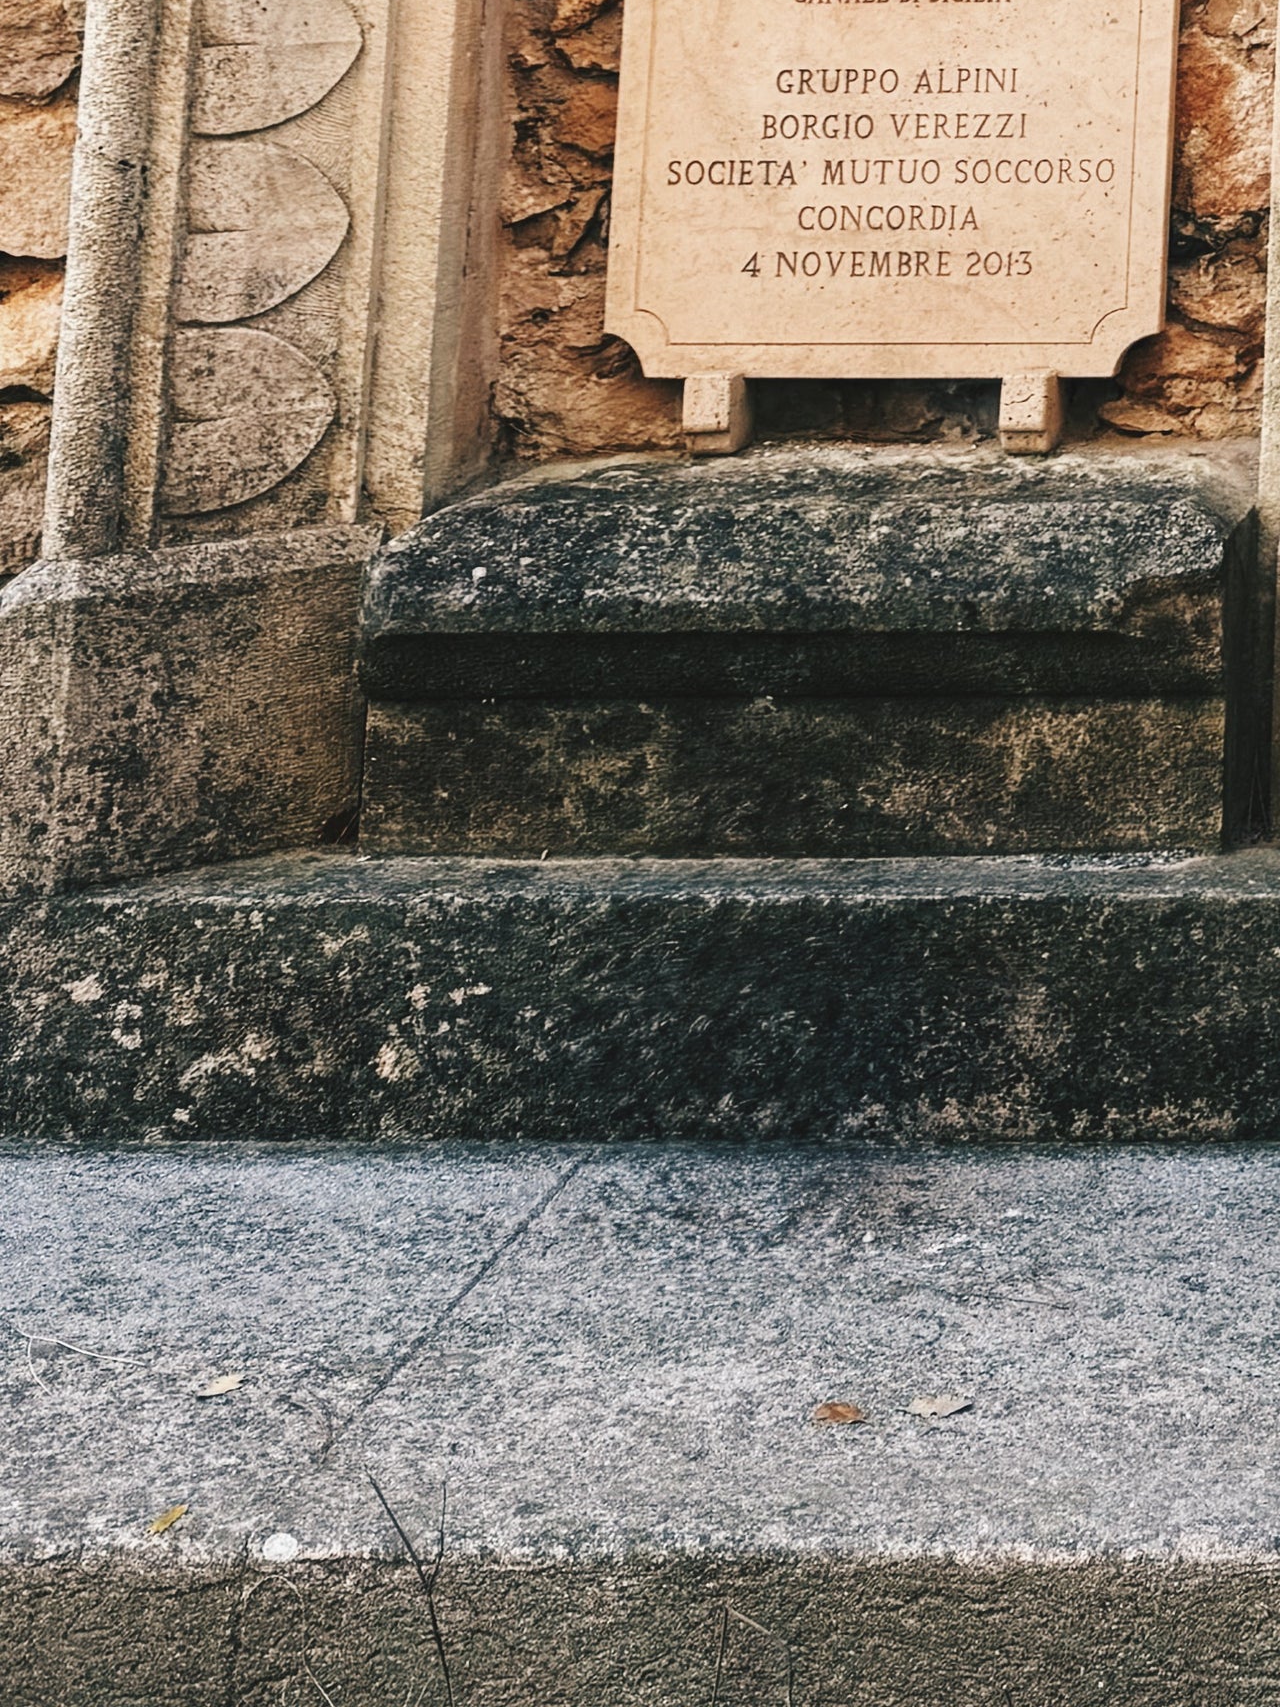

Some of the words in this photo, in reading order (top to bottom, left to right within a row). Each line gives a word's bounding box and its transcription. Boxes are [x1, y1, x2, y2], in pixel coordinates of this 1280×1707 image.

[776, 69, 899, 95] GRUPPO
[914, 68, 1017, 93] ALPINI
[762, 115, 874, 139] BORGIO
[892, 114, 1027, 139] VEREZZI
[667, 159, 806, 186] SOCIETA'
[822, 160, 941, 185] MUTUO
[954, 159, 1116, 184] SOCCORSO
[798, 206, 979, 231] CONCORDIA
[741, 254, 761, 277] 4
[775, 252, 951, 277] NOVEMBRE
[966, 251, 1032, 276] 2013
